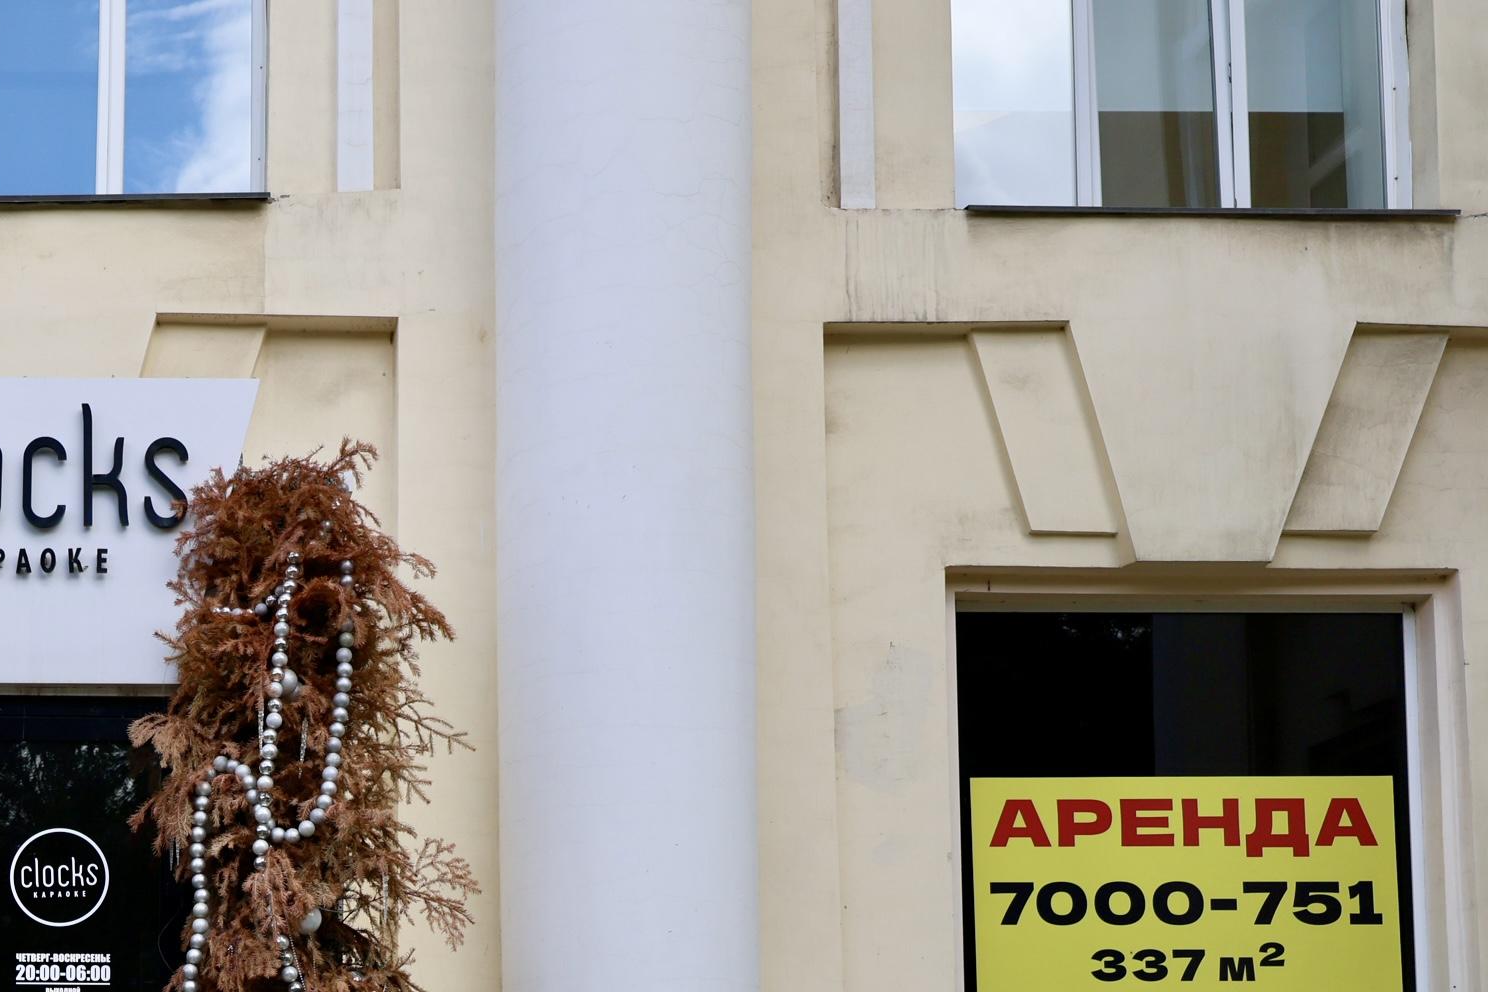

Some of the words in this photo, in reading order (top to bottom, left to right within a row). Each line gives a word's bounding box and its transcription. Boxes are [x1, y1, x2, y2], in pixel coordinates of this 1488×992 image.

[989, 798, 1379, 857] АРЕНДА
[20, 857, 99, 888] clocks
[33, 890, 87, 899] КАРАОКЕ
[989, 881, 1384, 926] 7000-751
[15, 953, 111, 963] ЧЕТВЕРГ-ВОСКРЕСЕНЬЕ
[15, 964, 111, 982] 20:00-06:00
[1090, 949, 1206, 982] 337
